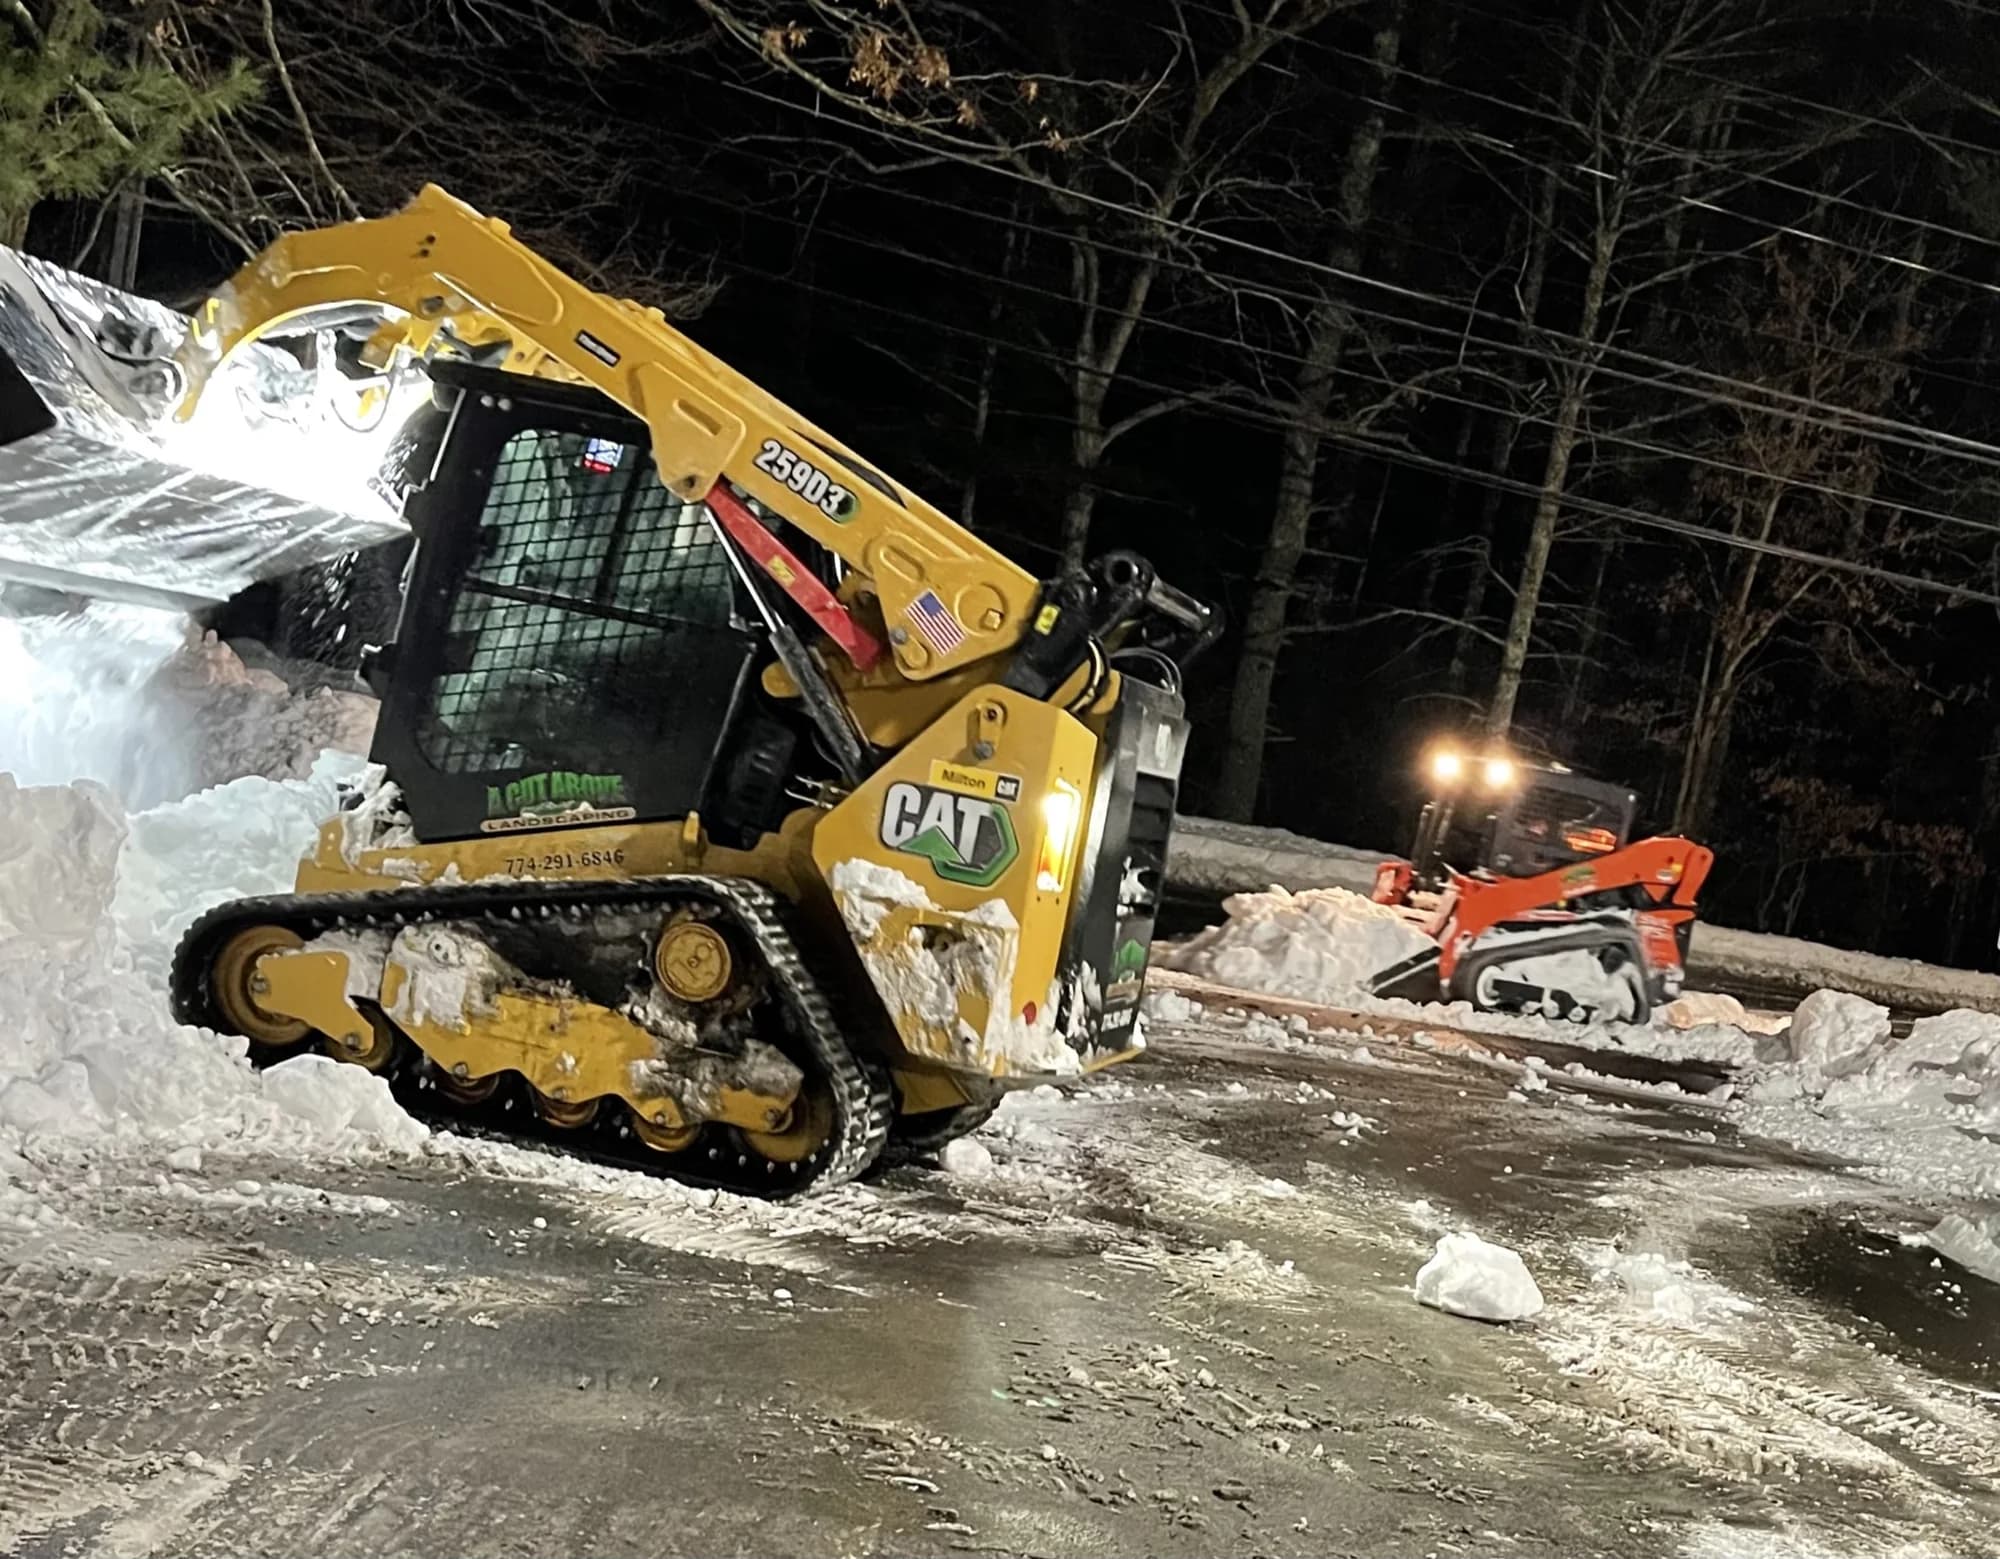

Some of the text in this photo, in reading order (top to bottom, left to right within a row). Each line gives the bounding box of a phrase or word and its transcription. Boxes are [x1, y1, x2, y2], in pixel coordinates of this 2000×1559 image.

[753, 438, 850, 516] 259D3
[487, 786, 504, 815] A
[505, 774, 547, 808] CUT
[487, 809, 630, 830] LANDSCAPING
[881, 782, 993, 864] CAT
